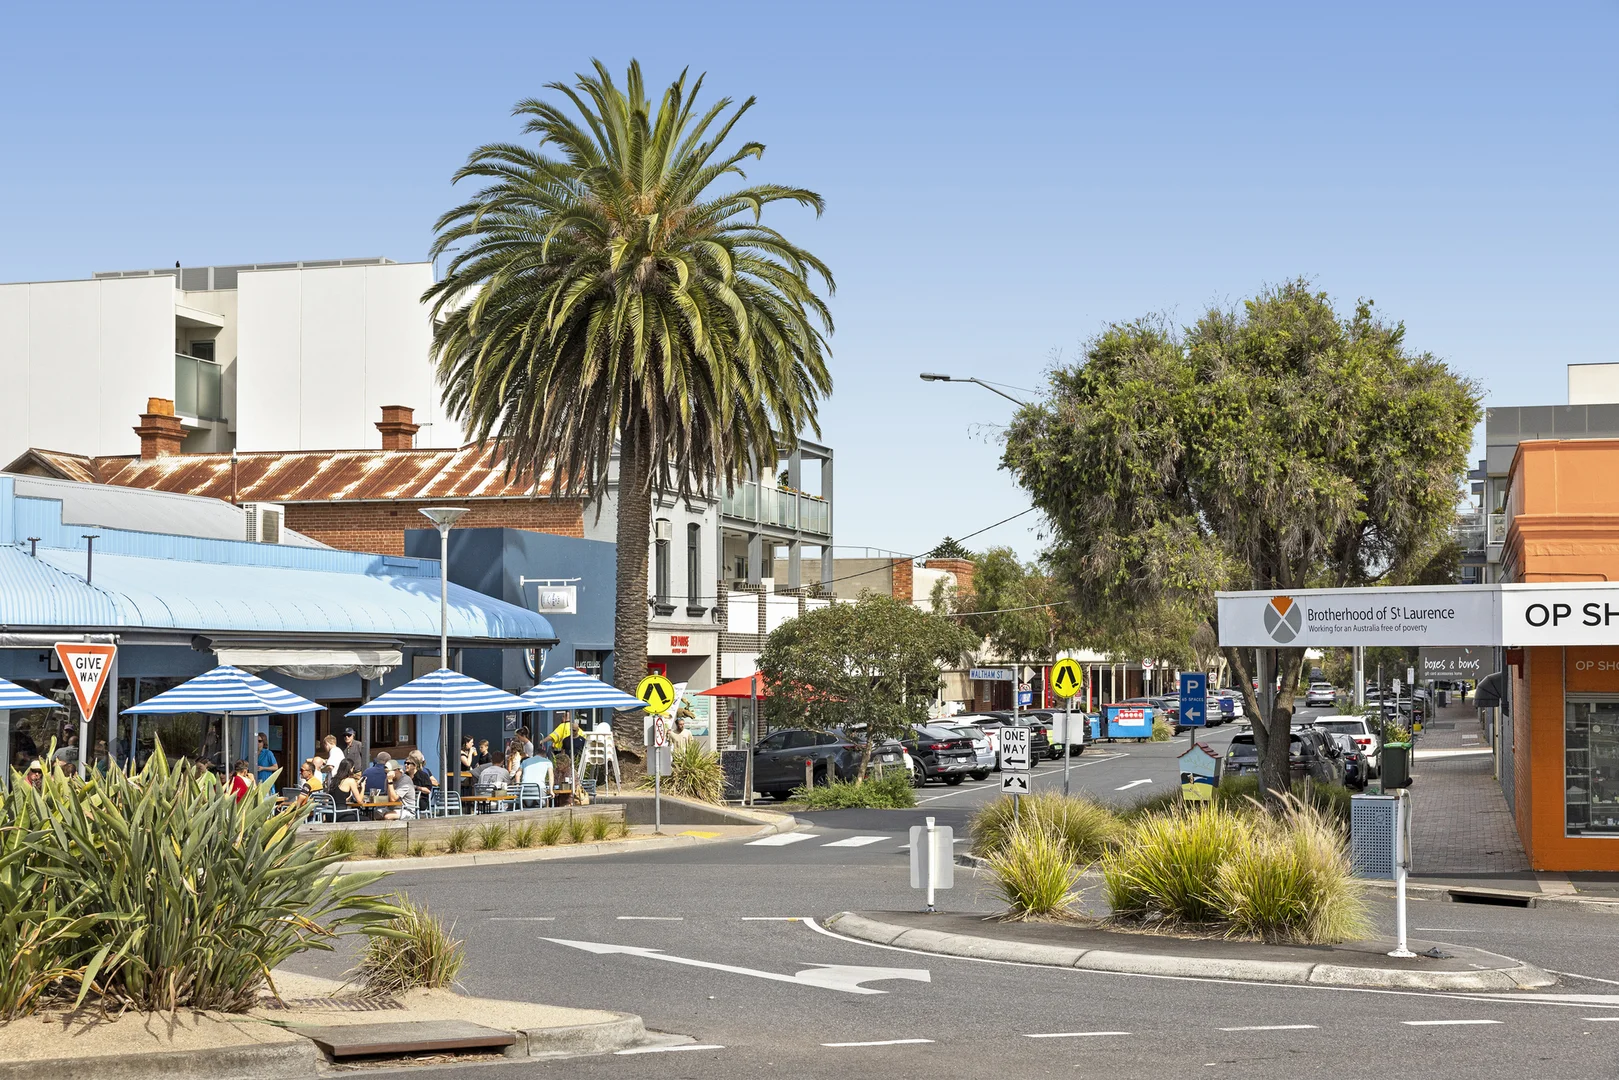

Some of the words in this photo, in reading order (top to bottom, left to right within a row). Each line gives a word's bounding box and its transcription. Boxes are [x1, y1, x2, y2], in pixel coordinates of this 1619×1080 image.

[1308, 608, 1374, 620] Brotherhood
[1376, 606, 1386, 620] of
[1390, 606, 1400, 620] St
[1404, 607, 1454, 620] Laurence
[1525, 603, 1572, 627] OP
[1308, 624, 1334, 634] Working
[1334, 624, 1343, 632] for
[1402, 624, 1427, 633] poverty
[76, 657, 102, 670] GIVE
[1425, 656, 1446, 670] boxes
[1450, 660, 1455, 669] &
[1458, 656, 1480, 670] bows
[1576, 660, 1594, 670] OP
[80, 672, 98, 682] WAY
[971, 670, 995, 679] WALTHAM
[996, 670, 1003, 679] ST
[1187, 680, 1199, 694] P
[1004, 730, 1025, 741] ONE
[1003, 744, 1026, 754] WAY
